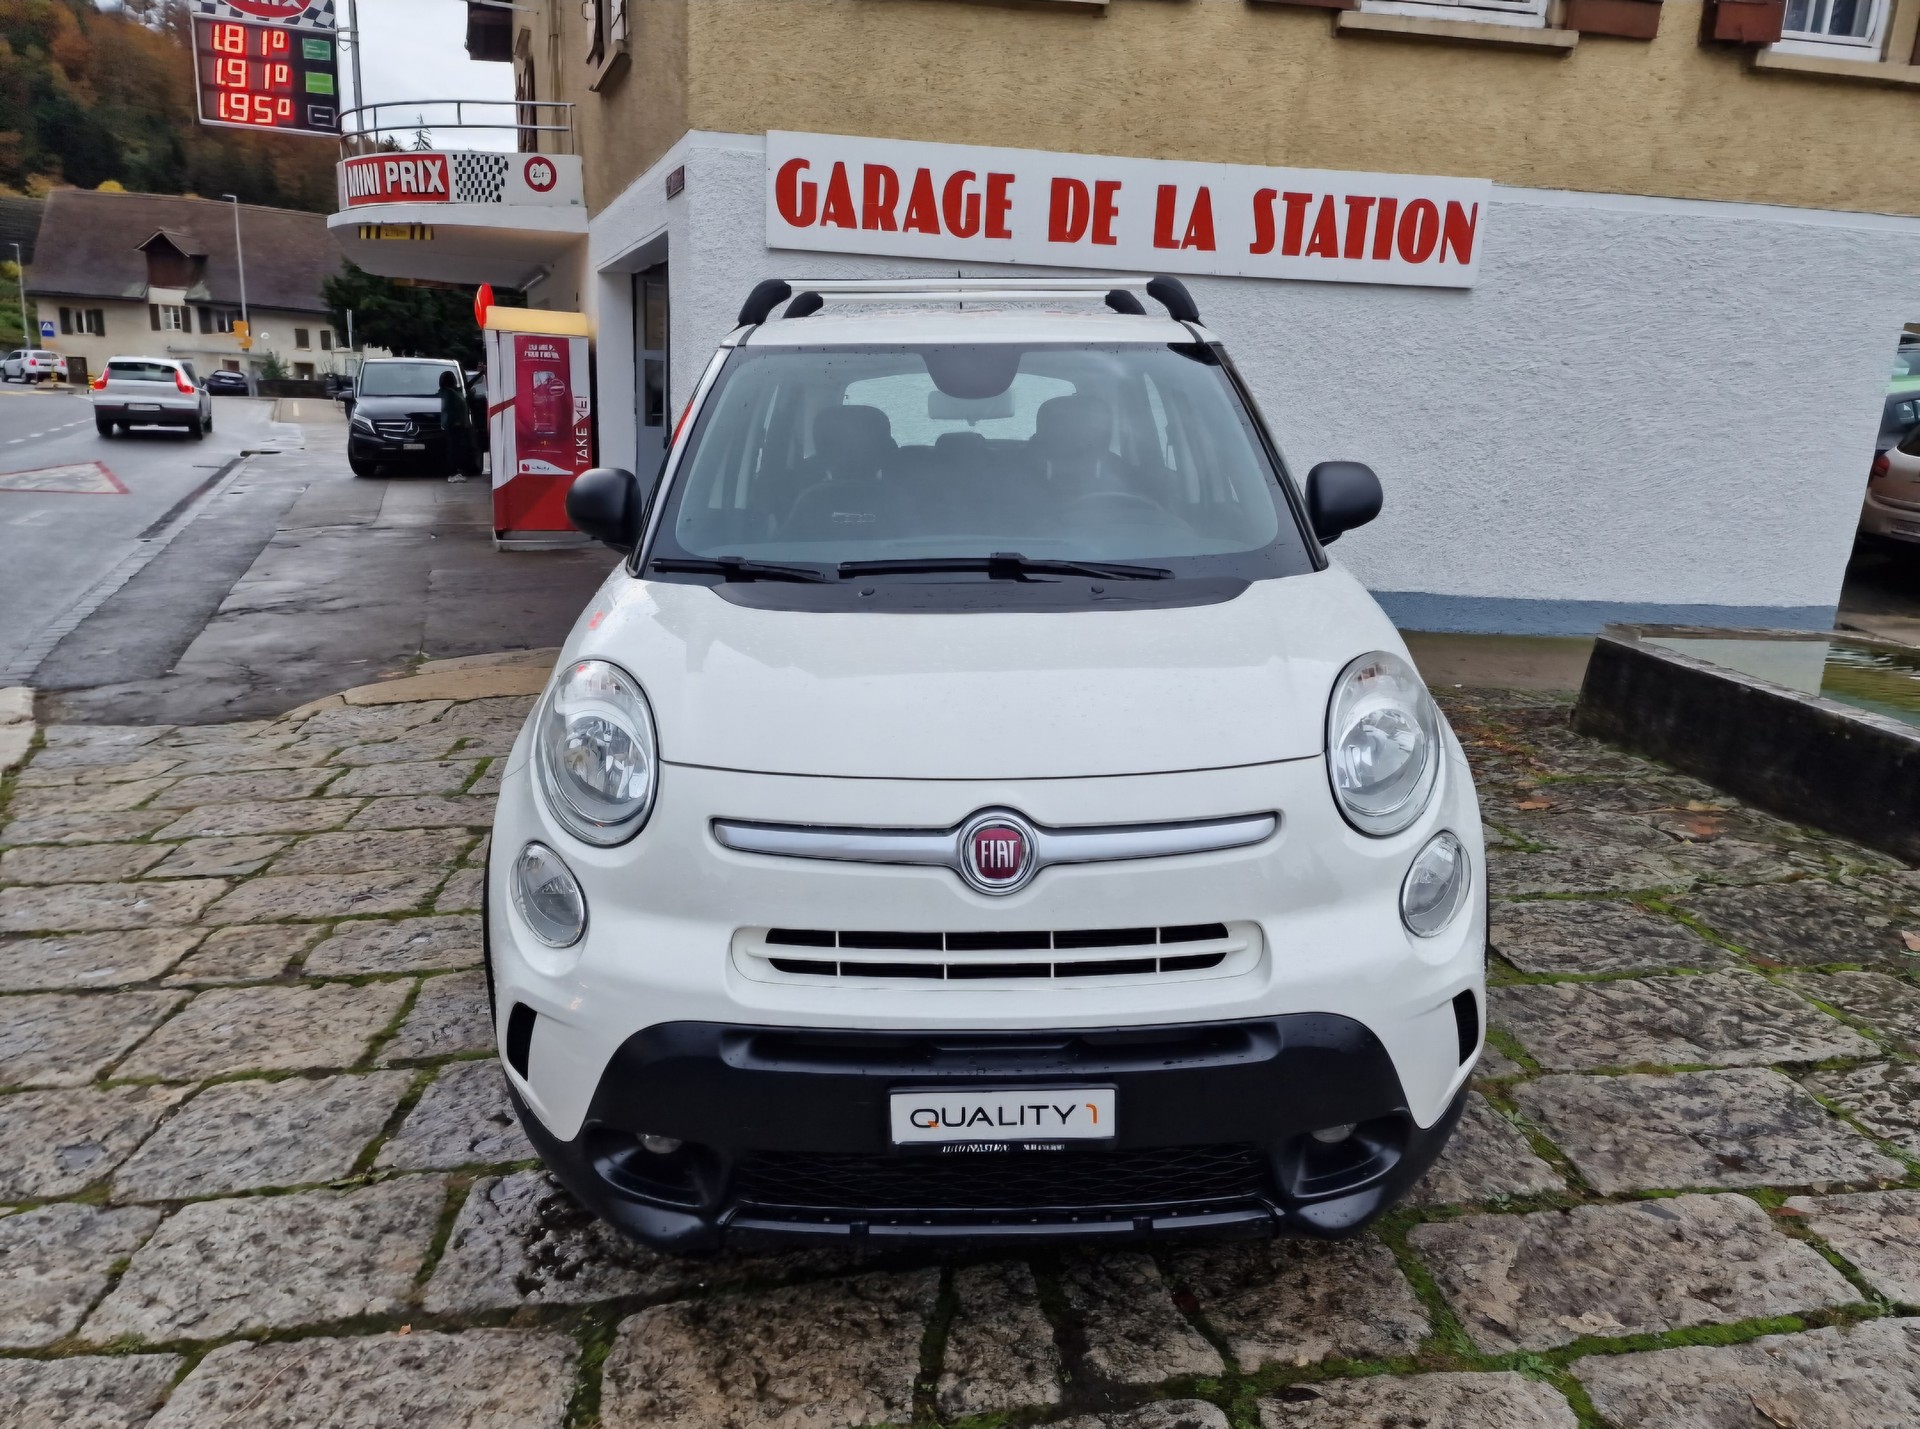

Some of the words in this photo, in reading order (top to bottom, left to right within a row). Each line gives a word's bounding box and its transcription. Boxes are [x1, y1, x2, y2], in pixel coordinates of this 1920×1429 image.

[347, 162, 381, 198] MINI
[384, 159, 446, 194] PRIX
[775, 157, 1016, 240] GARAGE
[1048, 177, 1122, 246] DE
[1153, 184, 1217, 252] LA
[1249, 187, 1479, 266] STATION
[574, 395, 588, 423] ME!
[575, 427, 589, 466] TAKE
[981, 840, 1018, 868] FIAT
[909, 1104, 1077, 1129] QUALITY
[1085, 1103, 1098, 1125] 1
